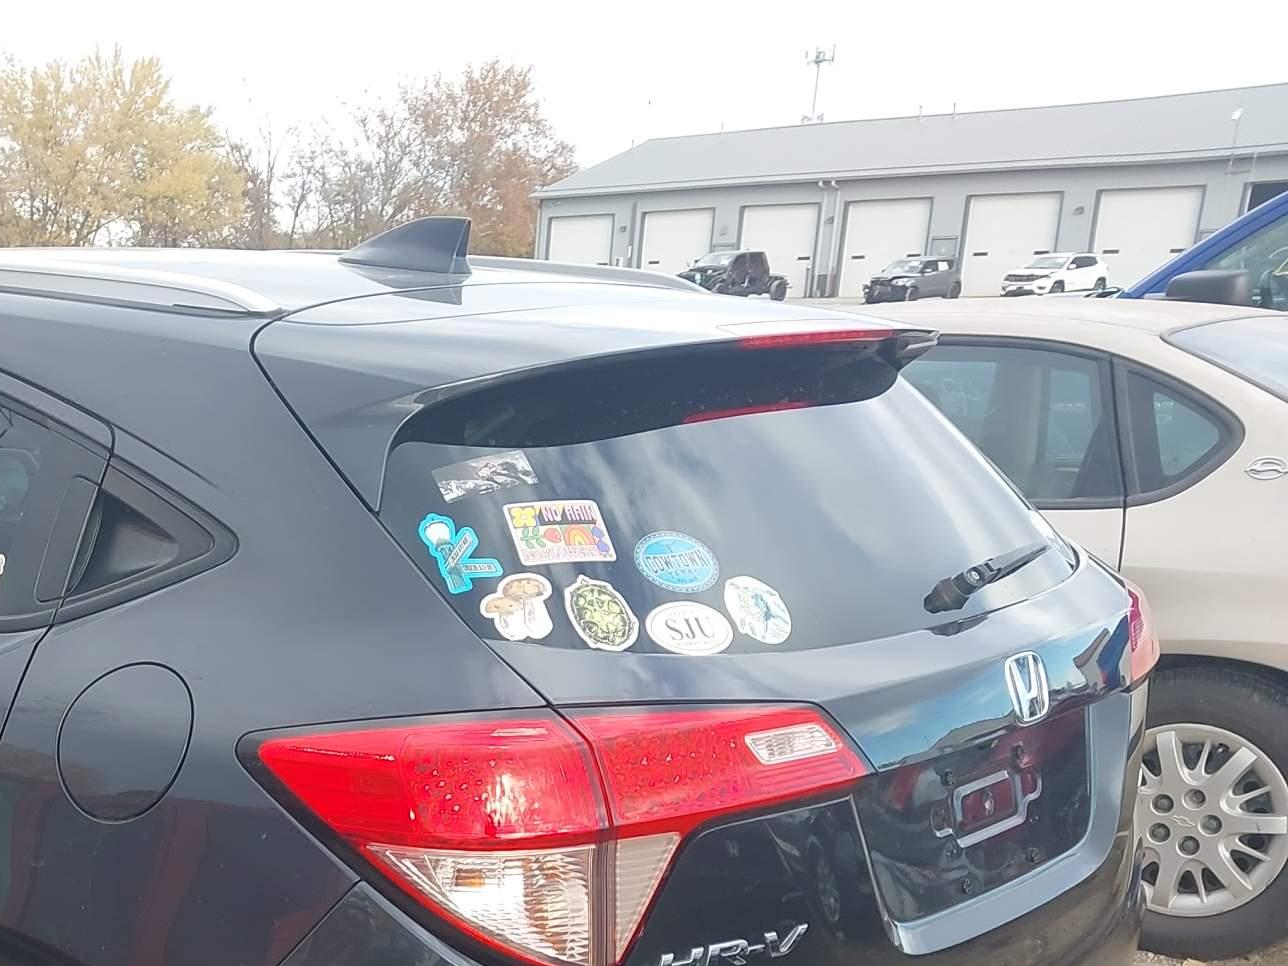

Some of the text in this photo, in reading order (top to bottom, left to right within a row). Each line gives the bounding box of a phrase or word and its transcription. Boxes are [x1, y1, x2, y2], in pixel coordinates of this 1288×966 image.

[542, 503, 598, 521] NO RAIN
[645, 549, 710, 574] COWTOWN
[665, 616, 715, 641] SJU
